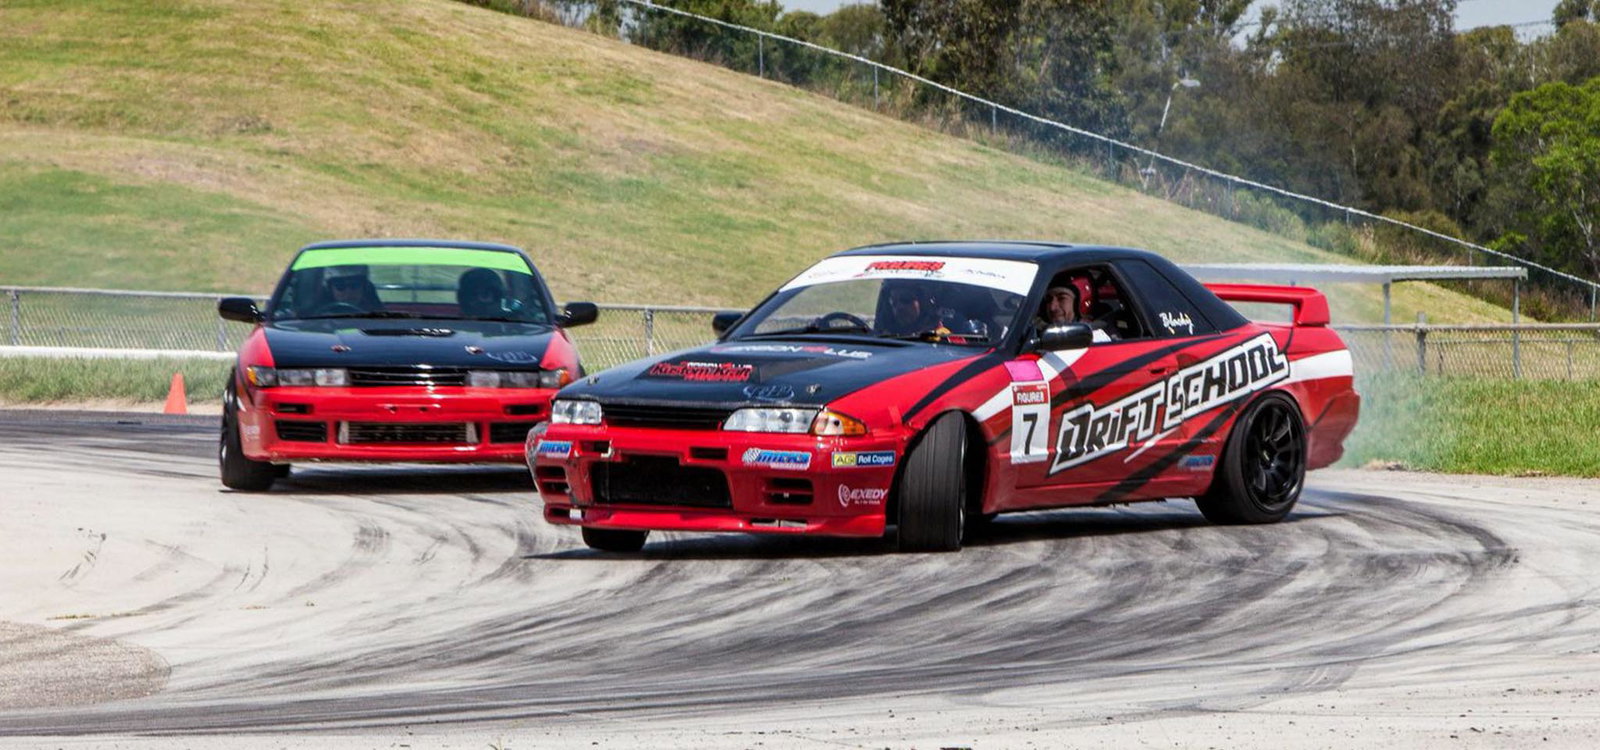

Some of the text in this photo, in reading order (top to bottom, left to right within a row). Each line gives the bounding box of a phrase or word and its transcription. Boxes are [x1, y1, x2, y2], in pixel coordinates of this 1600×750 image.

[1168, 341, 1285, 419] SCHOOL
[1023, 412, 1038, 455] 7
[858, 455, 871, 464] Roll
[850, 488, 889, 500] EXEDY
